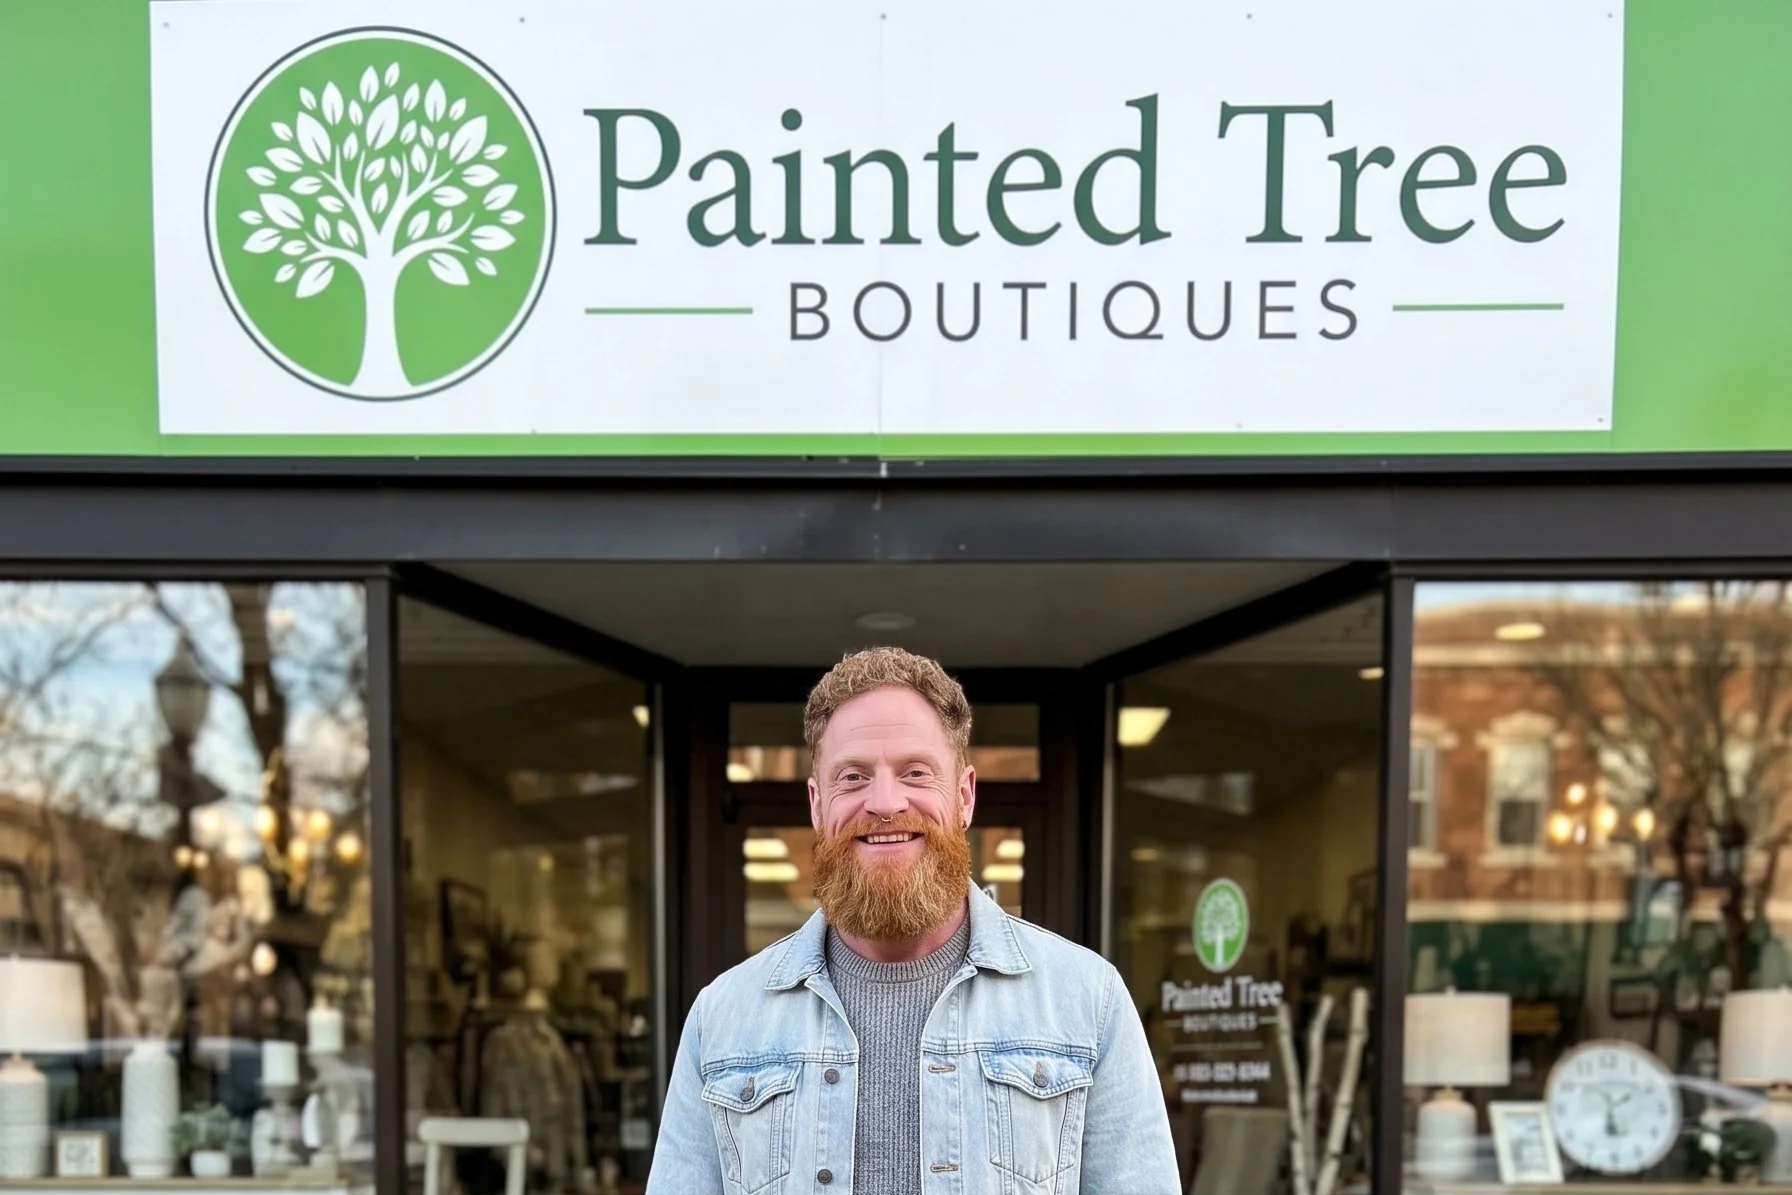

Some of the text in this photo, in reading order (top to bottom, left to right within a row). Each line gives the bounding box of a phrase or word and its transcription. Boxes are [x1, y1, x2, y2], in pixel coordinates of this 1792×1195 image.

[583, 92, 1568, 247] Painted Tree
[789, 278, 1358, 342] BOUTIQUES
[1161, 976, 1284, 1012] Painted Tree
